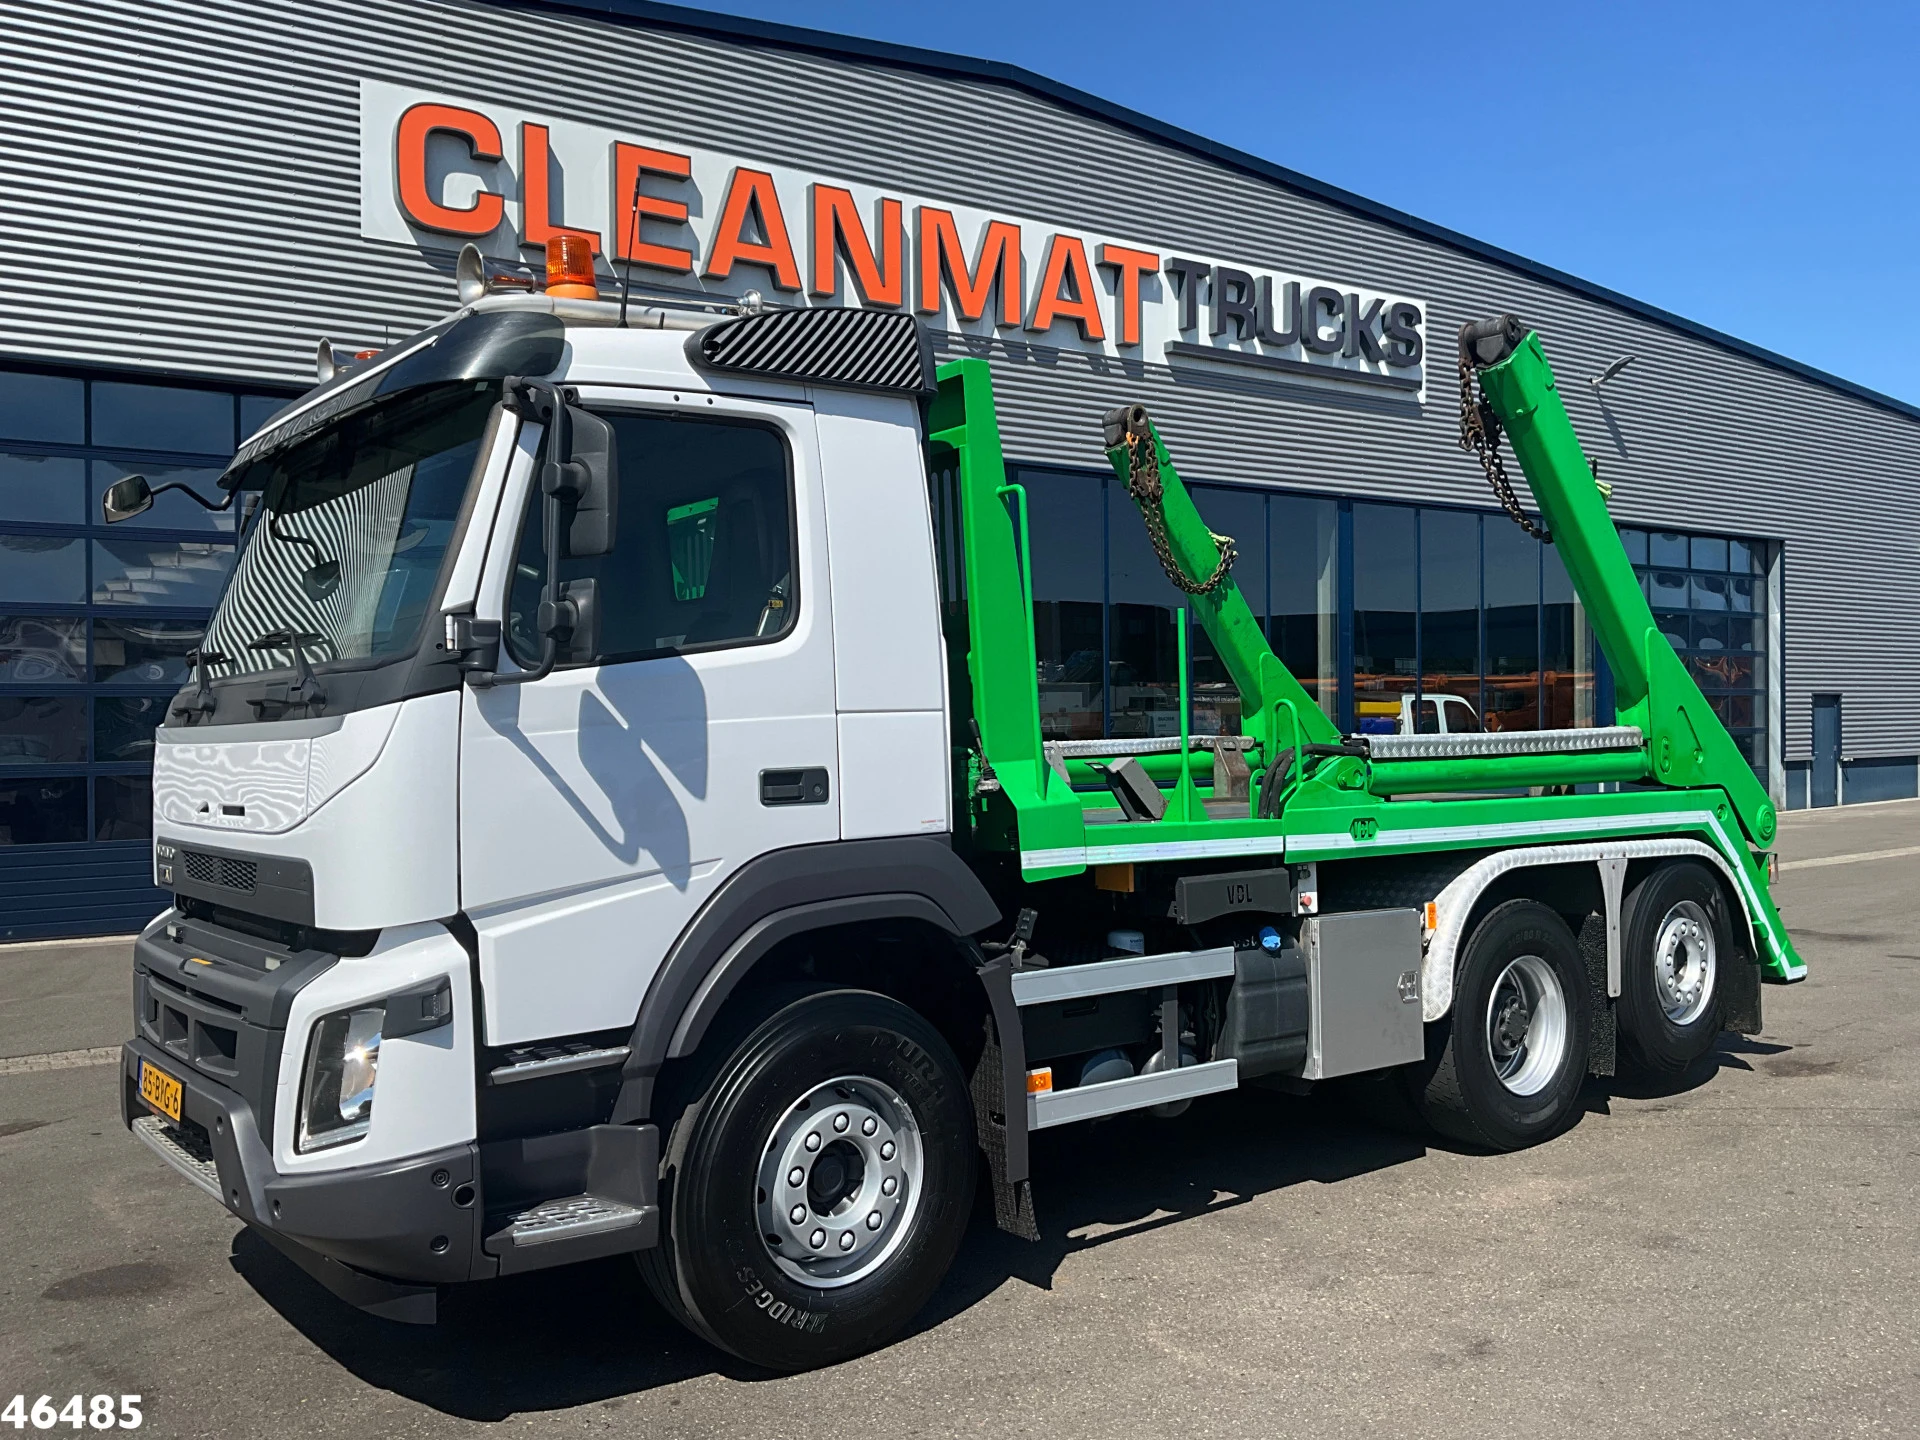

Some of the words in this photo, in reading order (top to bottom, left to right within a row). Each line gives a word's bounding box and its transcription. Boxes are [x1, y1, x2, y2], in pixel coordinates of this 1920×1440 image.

[393, 101, 1160, 347] CLEANMAT
[1164, 256, 1424, 369] TRUCKS
[1351, 820, 1374, 839] VDL
[1227, 884, 1253, 905] VDL
